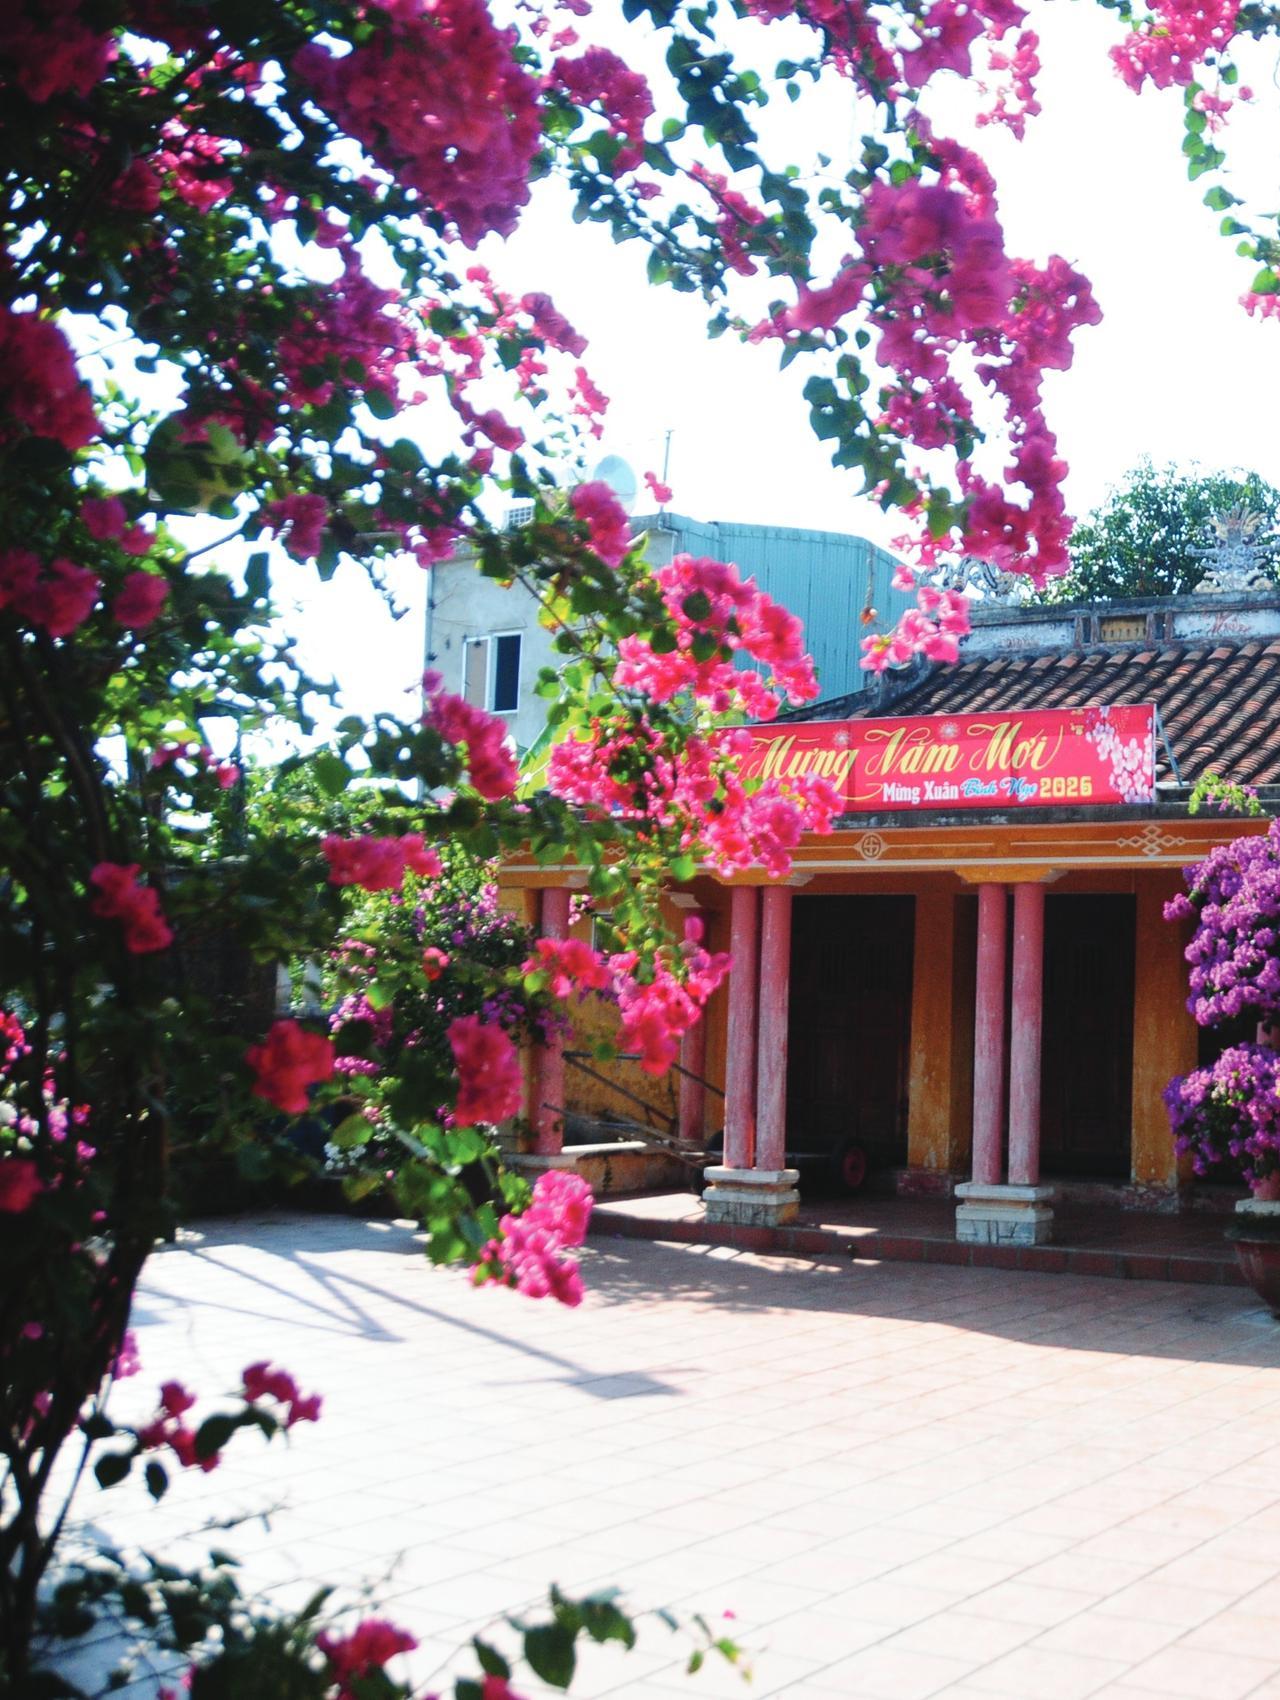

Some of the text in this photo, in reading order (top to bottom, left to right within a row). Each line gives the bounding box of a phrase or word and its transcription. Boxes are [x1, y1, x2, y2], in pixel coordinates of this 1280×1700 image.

[864, 727, 964, 776] Năm
[967, 721, 1063, 771] Mới
[923, 780, 959, 800] Xuân
[1040, 776, 1093, 797] 2026
